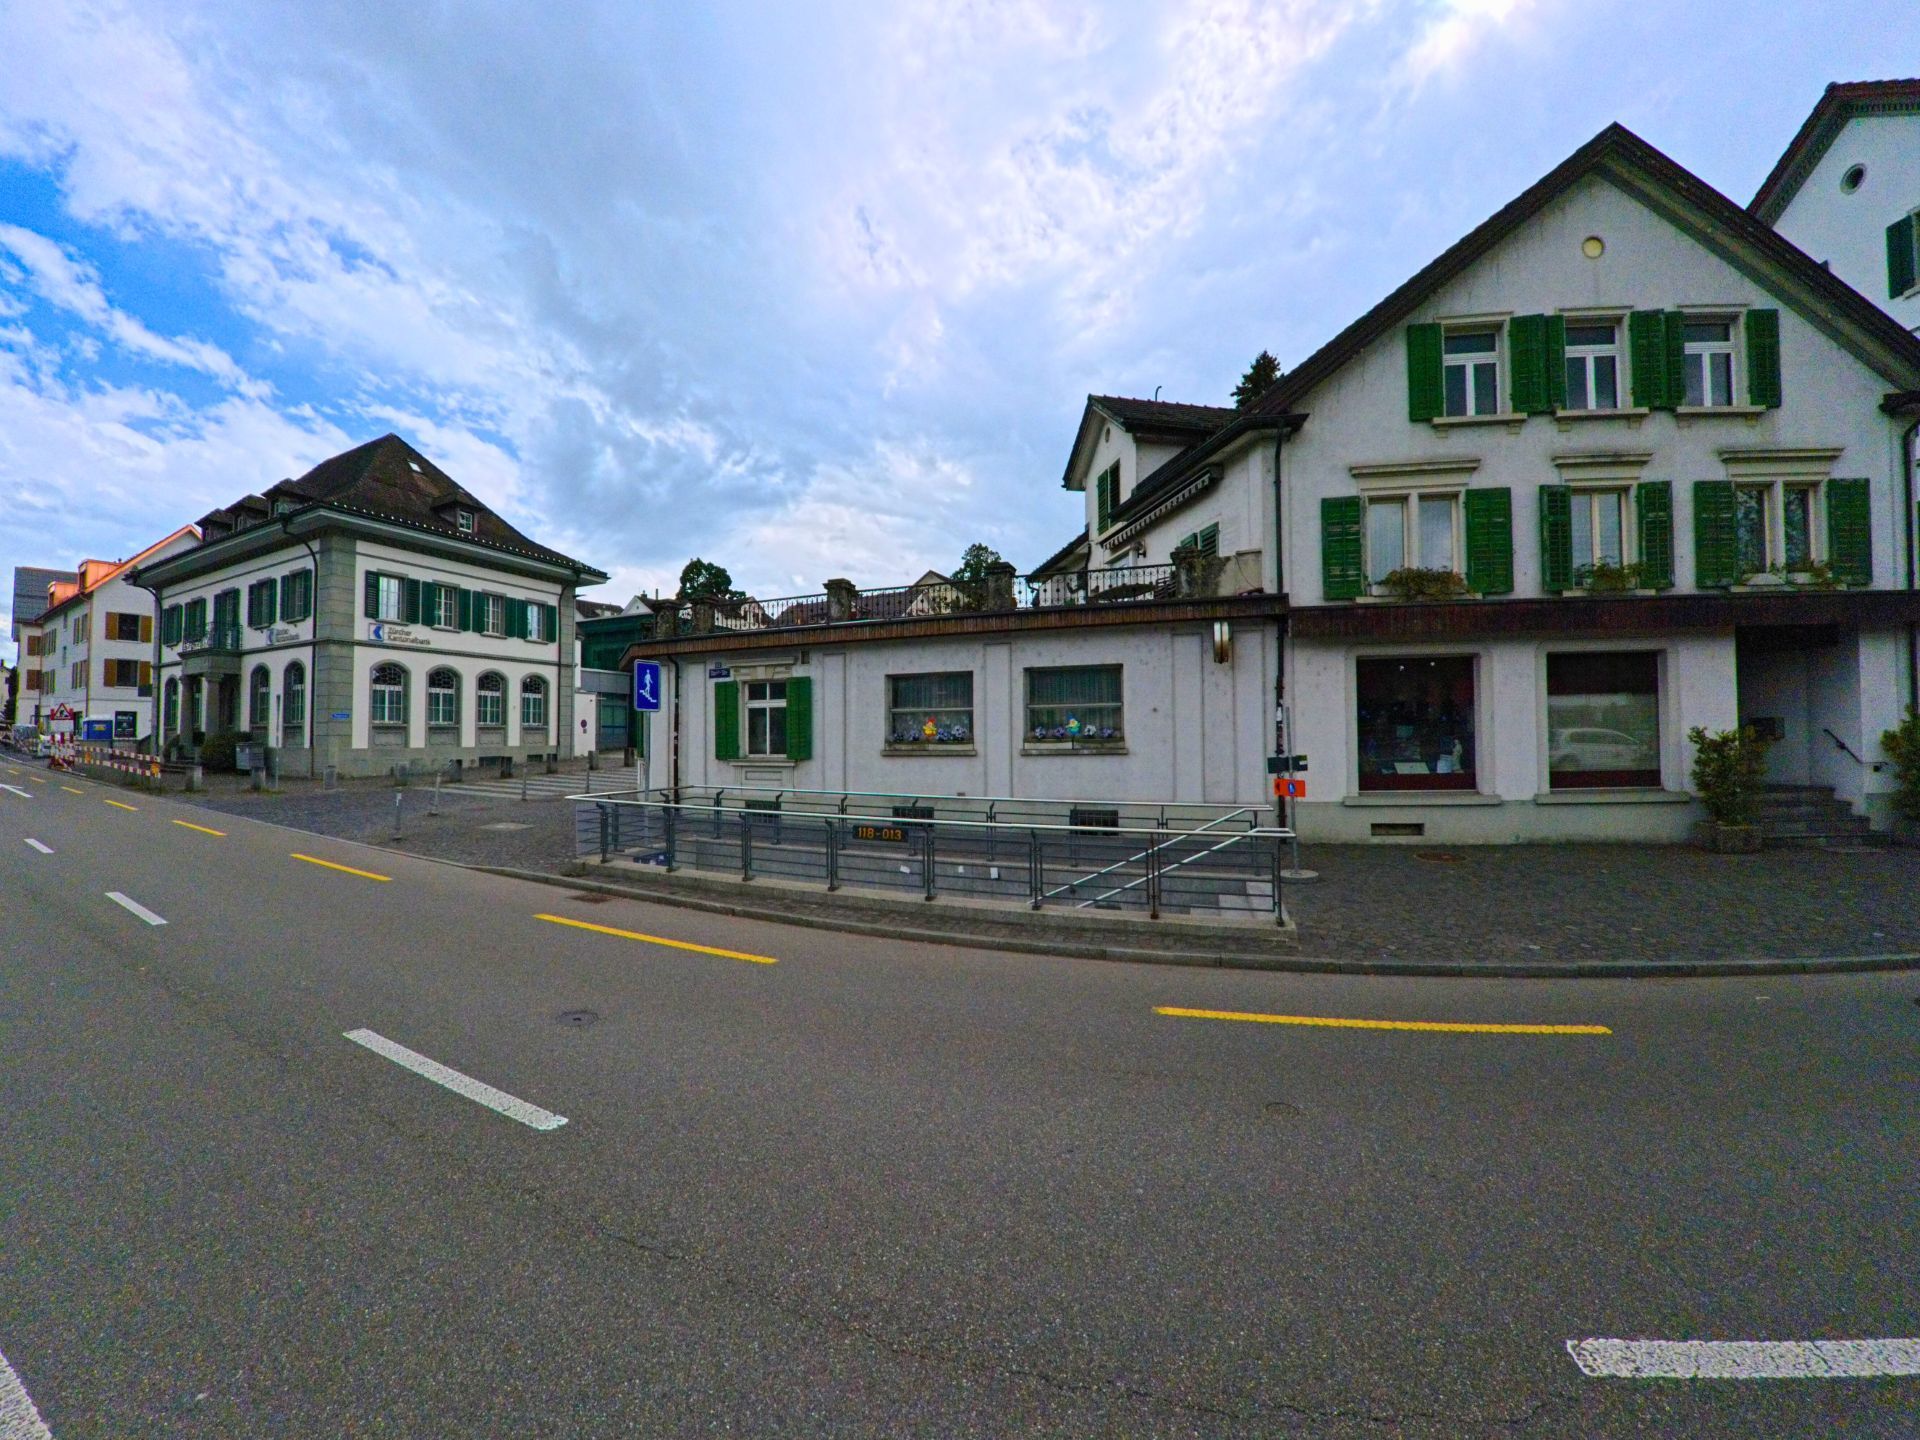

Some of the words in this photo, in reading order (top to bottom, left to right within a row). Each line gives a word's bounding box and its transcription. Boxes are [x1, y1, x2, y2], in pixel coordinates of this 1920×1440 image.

[387, 626, 412, 636] Zürcher
[387, 635, 431, 645] Kantonalbank
[858, 826, 902, 841] 118-013
